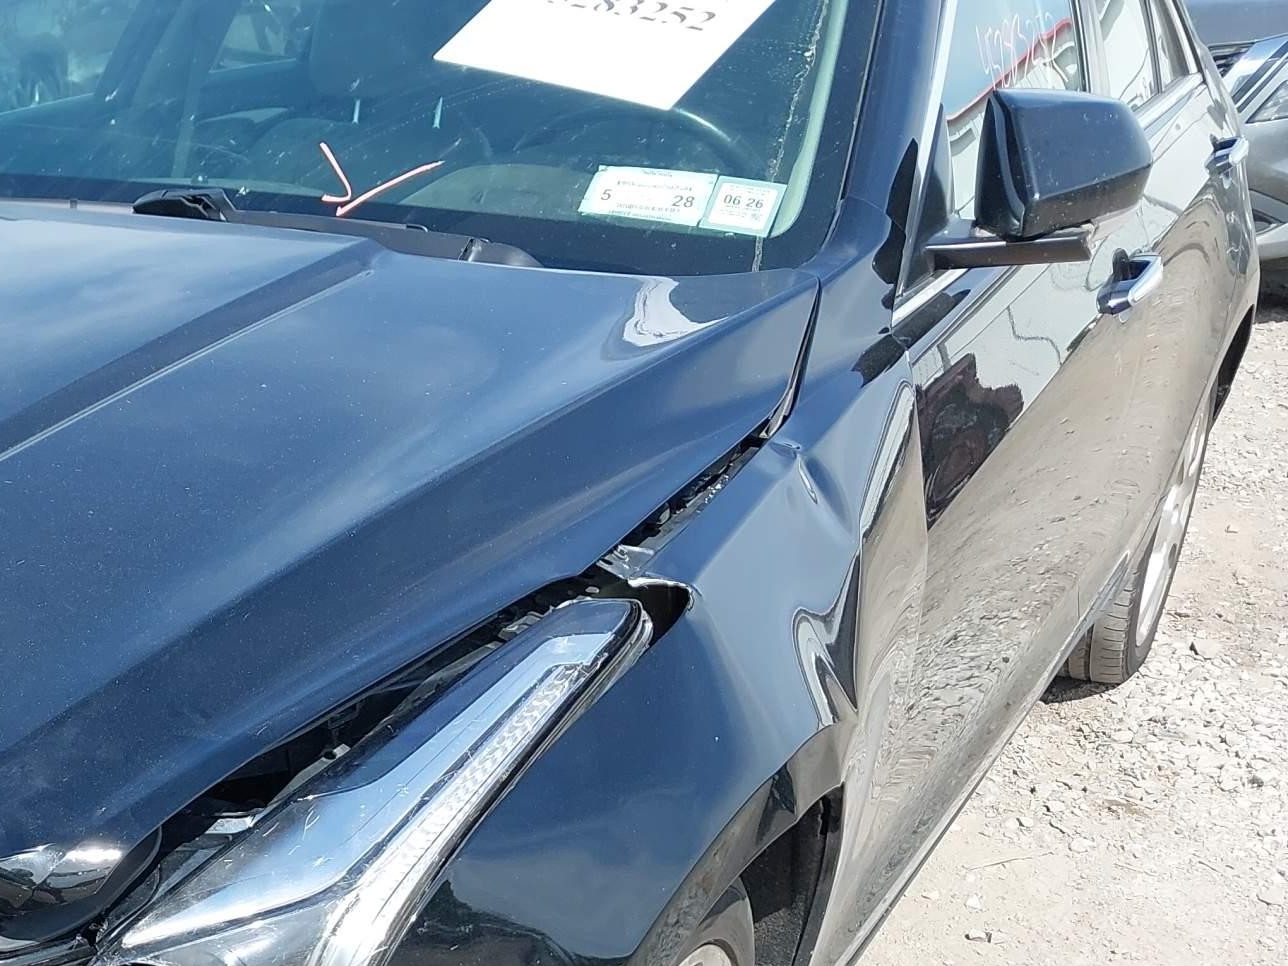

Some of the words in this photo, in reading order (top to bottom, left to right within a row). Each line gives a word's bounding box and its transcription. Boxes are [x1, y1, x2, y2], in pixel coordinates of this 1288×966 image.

[600, 188, 613, 201] 5
[672, 194, 695, 208] 28
[723, 194, 742, 206] 06
[746, 197, 764, 209] 26
